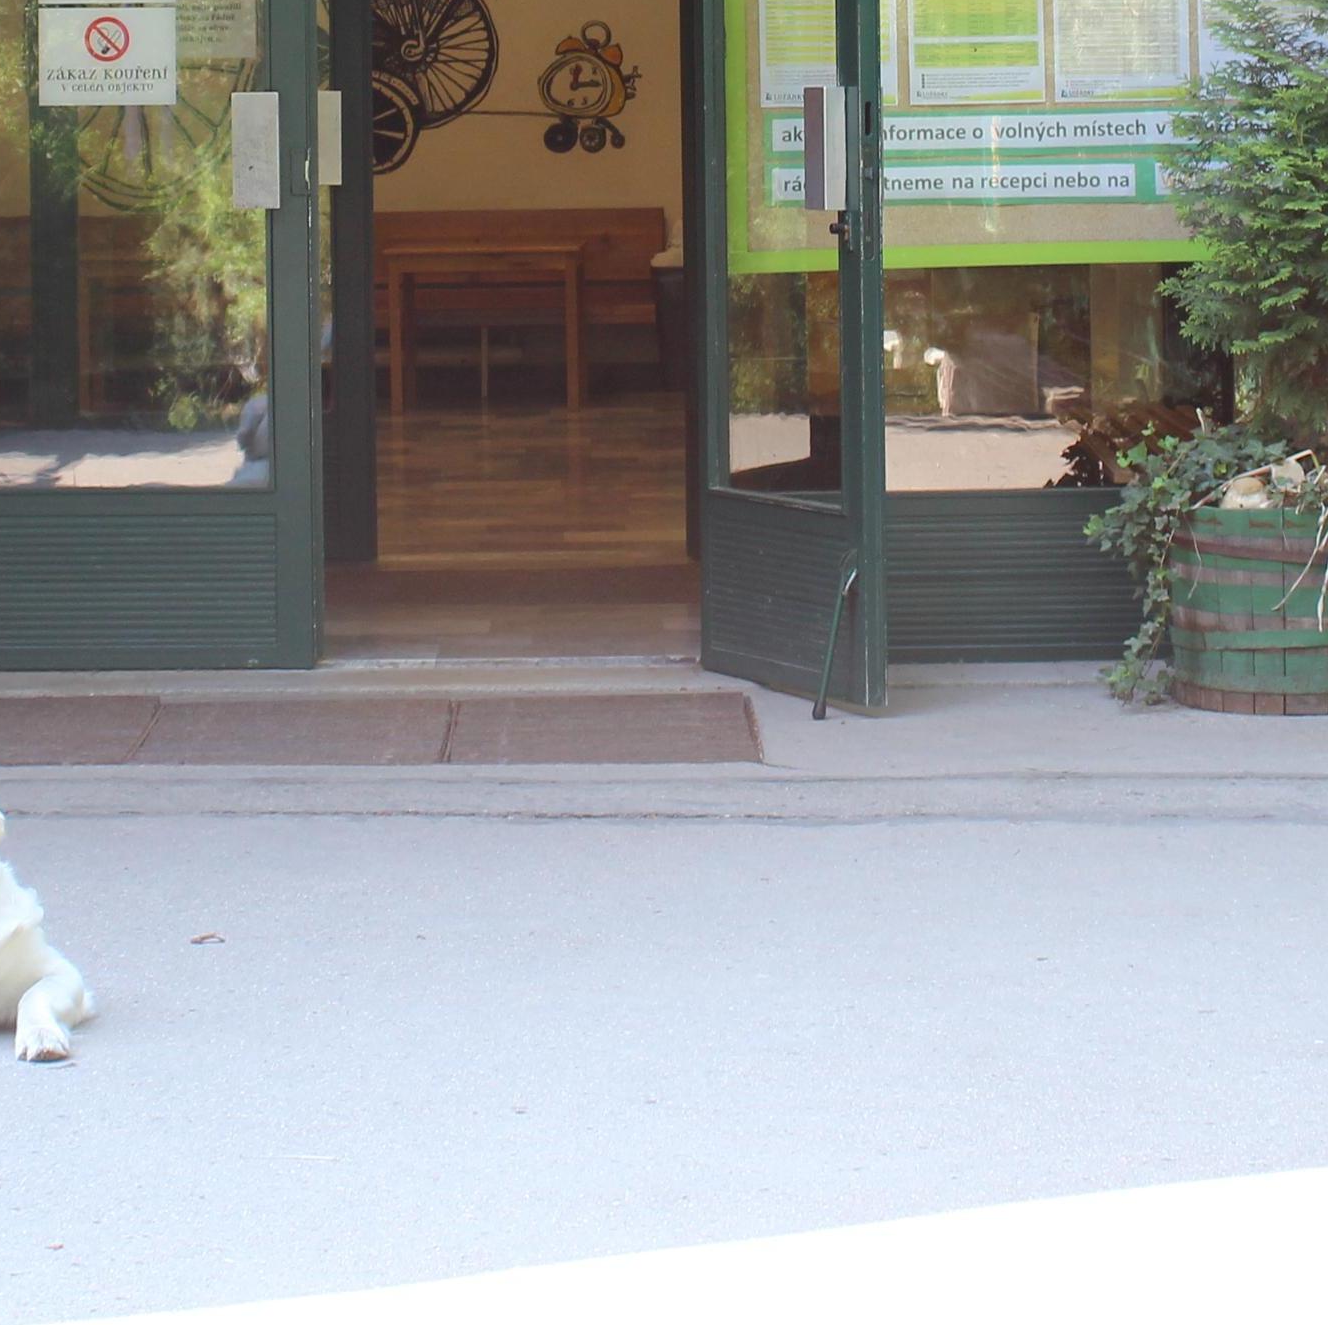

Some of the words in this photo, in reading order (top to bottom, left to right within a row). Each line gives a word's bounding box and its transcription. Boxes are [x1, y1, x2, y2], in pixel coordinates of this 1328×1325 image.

[883, 125, 966, 142] nformace
[972, 127, 984, 139] o
[995, 122, 1067, 142] volných
[1073, 119, 1146, 138] místech
[952, 178, 973, 190] na
[980, 172, 1048, 192] recepci
[1054, 172, 1101, 188] nebo
[1107, 175, 1130, 188] na
